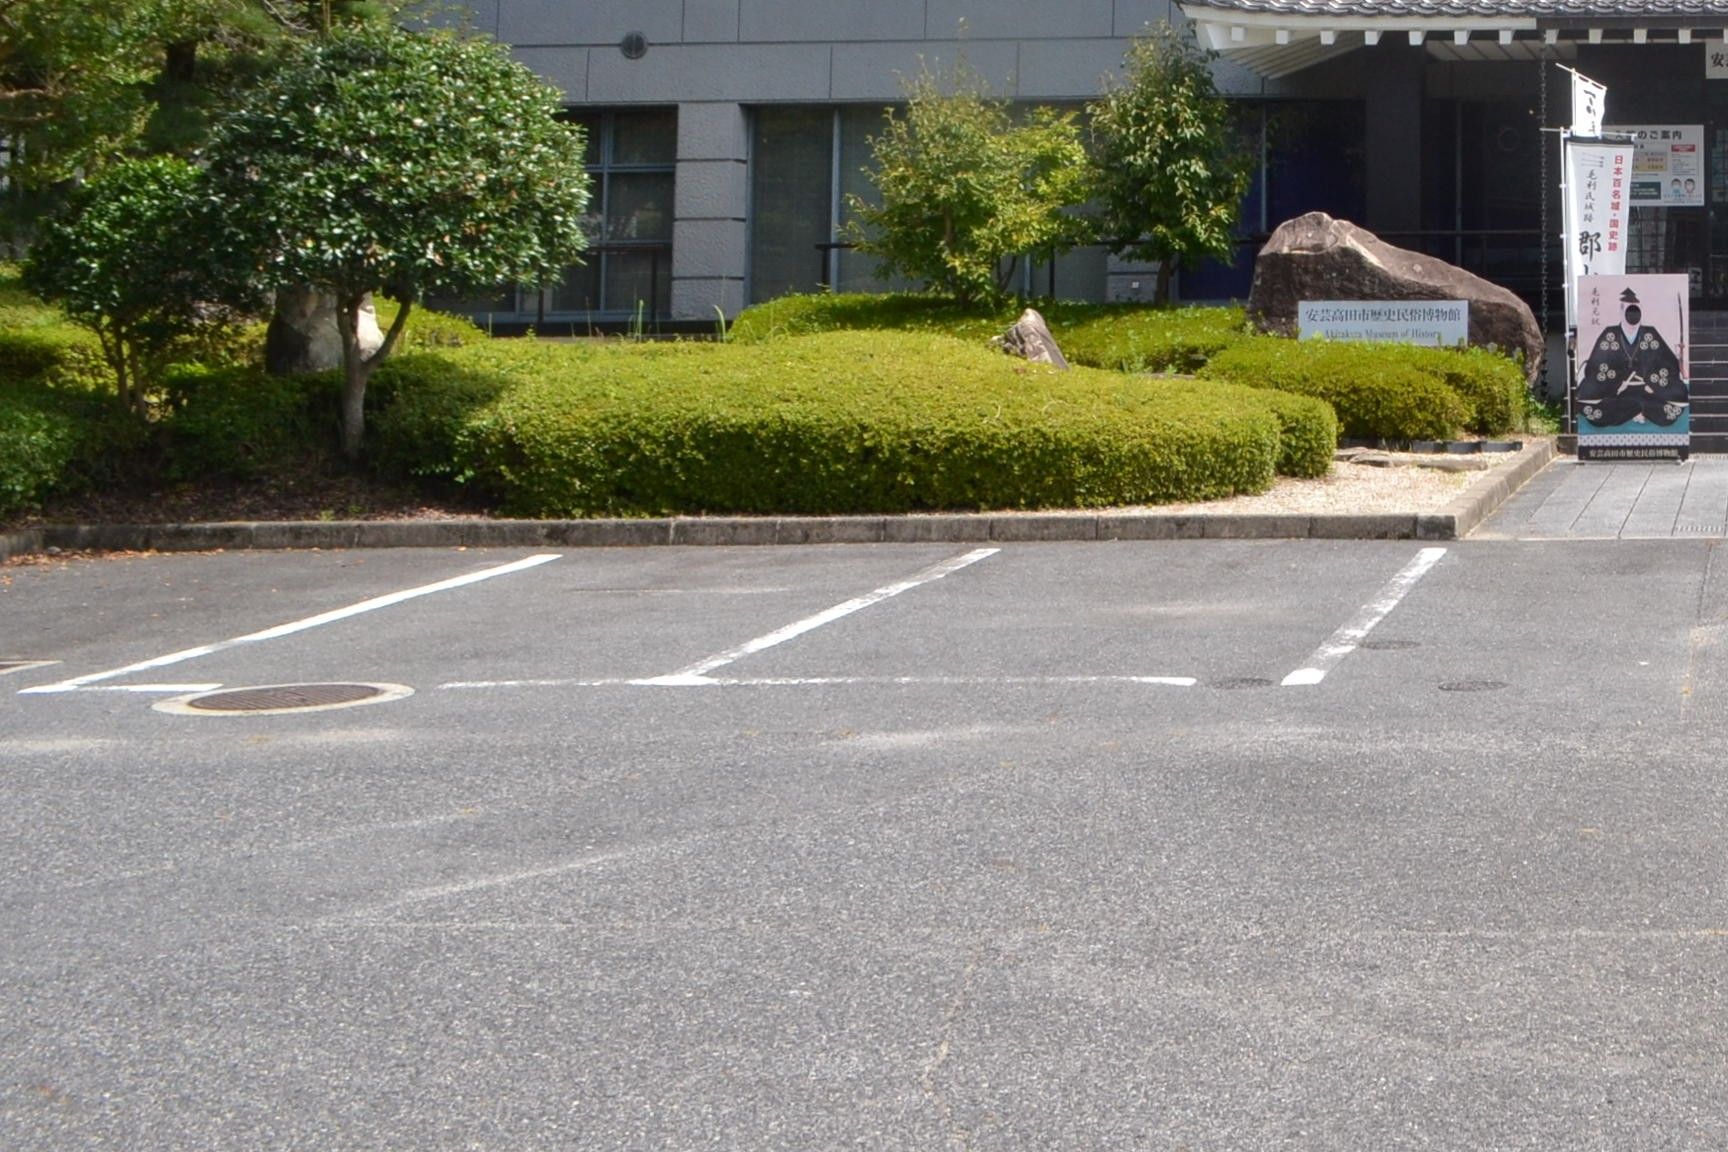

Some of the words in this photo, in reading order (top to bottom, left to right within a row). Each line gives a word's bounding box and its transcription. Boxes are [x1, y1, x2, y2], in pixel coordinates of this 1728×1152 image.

[1305, 308, 1461, 323] 安芸高田市歴史民俗博物館
[1365, 329, 1399, 339] Museum
[1400, 329, 1409, 339] of
